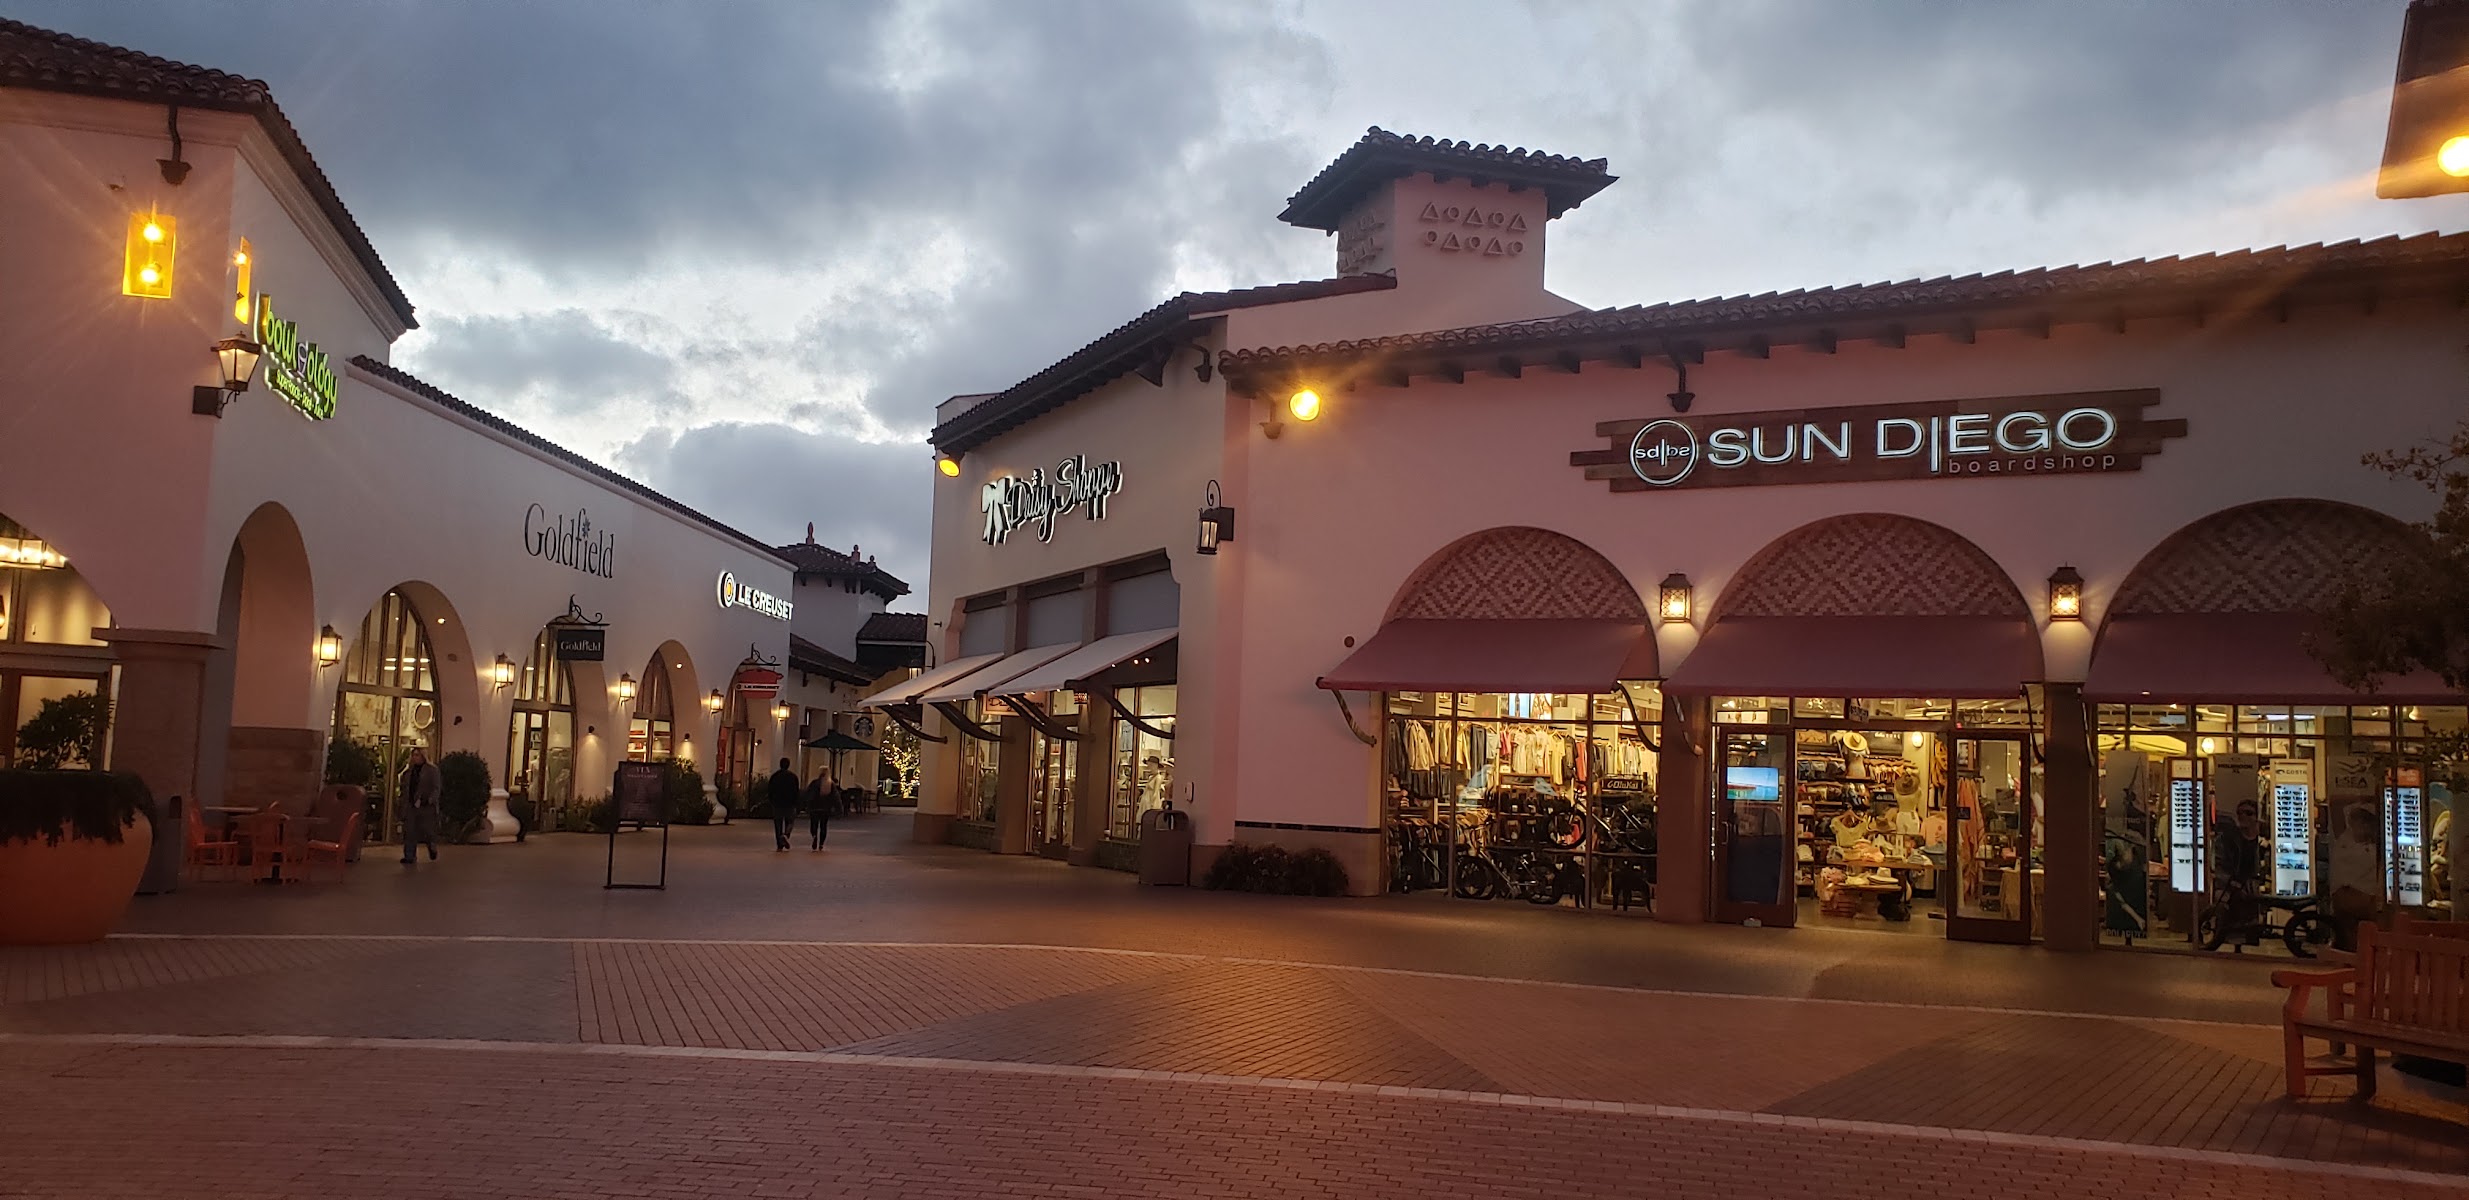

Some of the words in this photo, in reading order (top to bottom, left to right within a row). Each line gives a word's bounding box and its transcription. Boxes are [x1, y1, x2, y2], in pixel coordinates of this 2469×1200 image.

[1708, 421, 1850, 466] SUN
[1877, 407, 2116, 472] DIEGO
[1949, 454, 2116, 474] boardshop
[1006, 467, 1055, 542] Daisy
[1055, 455, 1121, 521] Shoppe
[524, 502, 614, 579] Goldfield
[737, 583, 753, 607] LE
[752, 589, 794, 621] CREUSET
[560, 639, 601, 651] Goldfield
